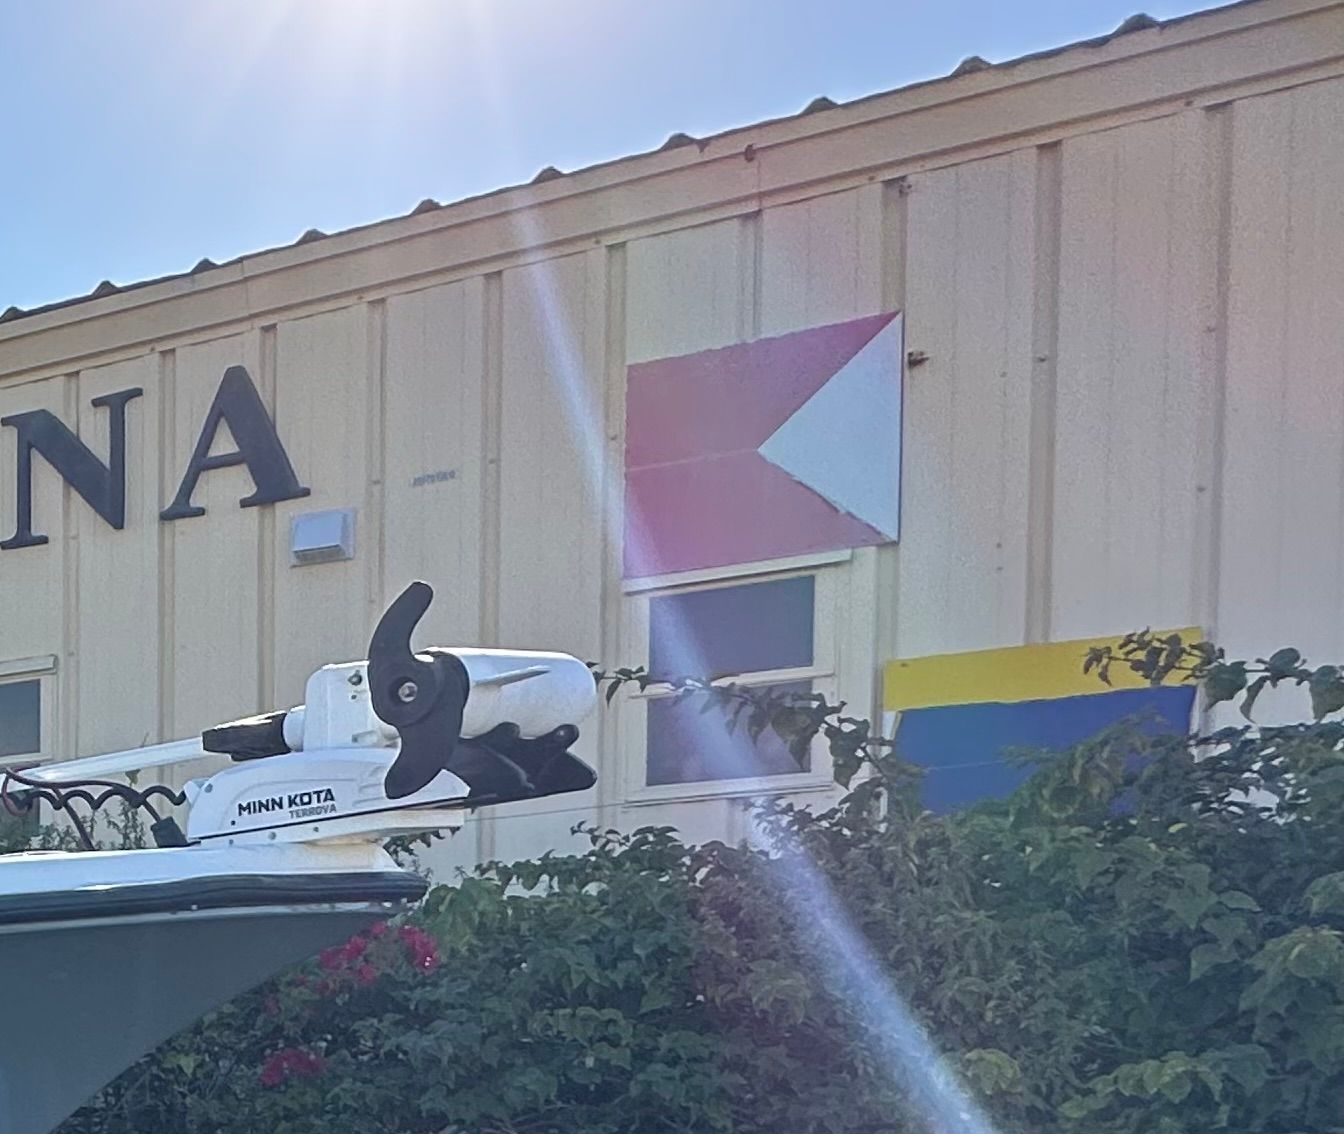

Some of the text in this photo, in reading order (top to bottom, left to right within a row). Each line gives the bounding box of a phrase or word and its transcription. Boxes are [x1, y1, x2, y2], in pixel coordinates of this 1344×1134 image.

[237, 788, 336, 817] MINN KOTA
[289, 804, 337, 819] TERROVA
